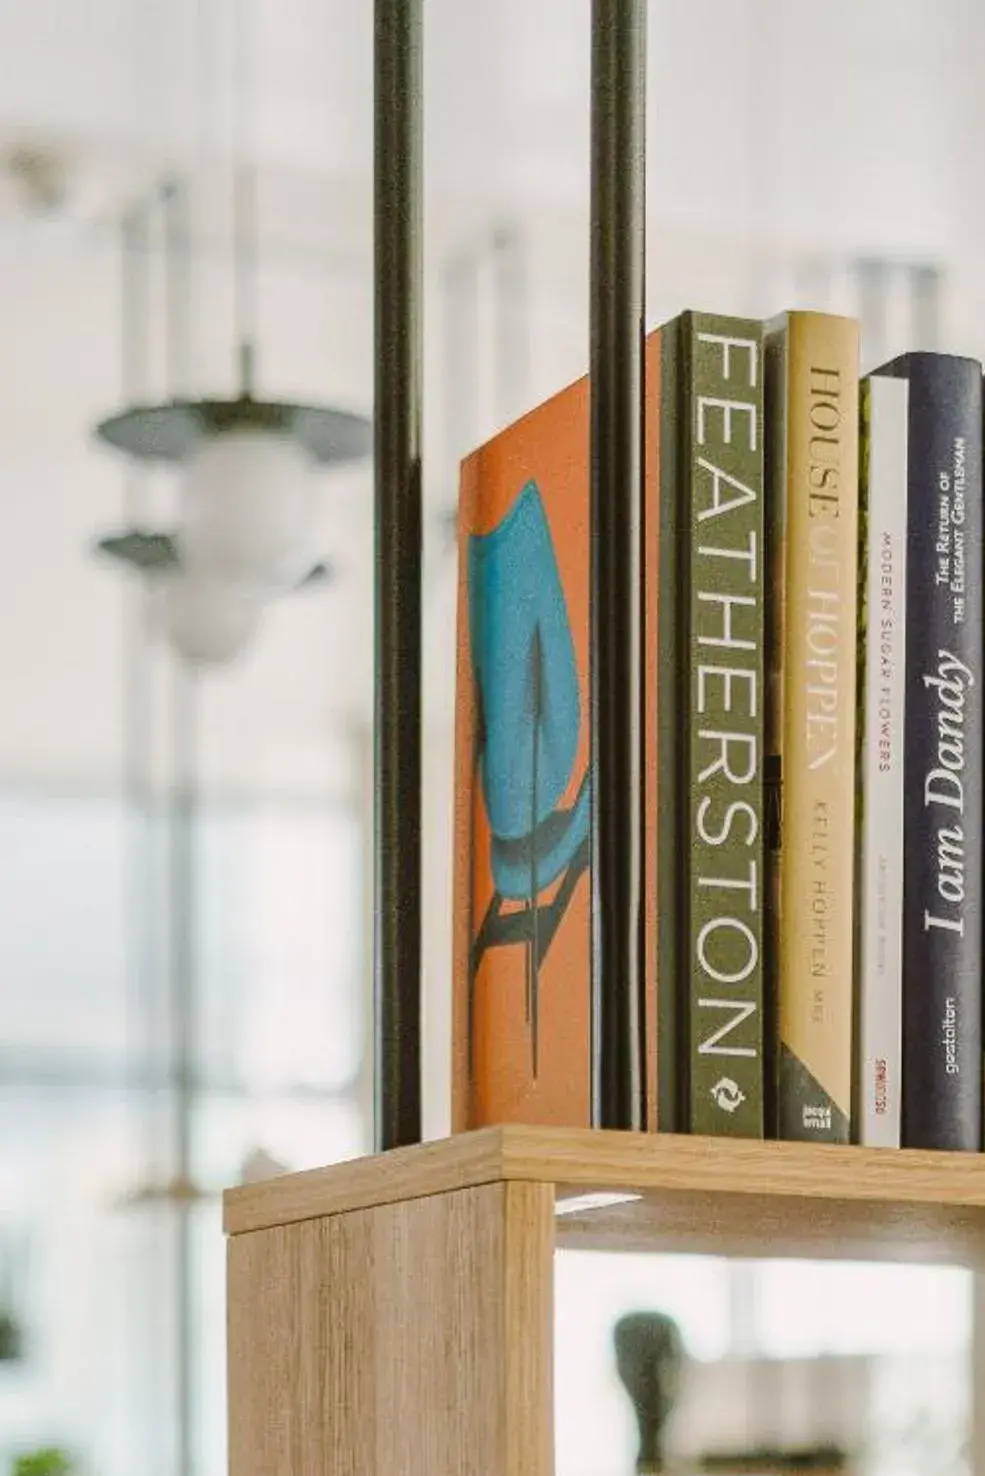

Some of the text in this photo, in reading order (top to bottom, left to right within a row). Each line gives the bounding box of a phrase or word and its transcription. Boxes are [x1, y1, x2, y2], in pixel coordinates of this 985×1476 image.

[808, 365, 841, 519] HOUSE
[696, 332, 758, 1057] FEATHERSTON
[806, 588, 840, 771] HOPPEN
[879, 531, 892, 773] MODERN SUGAR FLOWERS
[812, 801, 833, 870] KELLY
[922, 649, 975, 938] I am Dandy
[811, 881, 832, 978] HOPPEN
[942, 997, 960, 1074] gestalten
